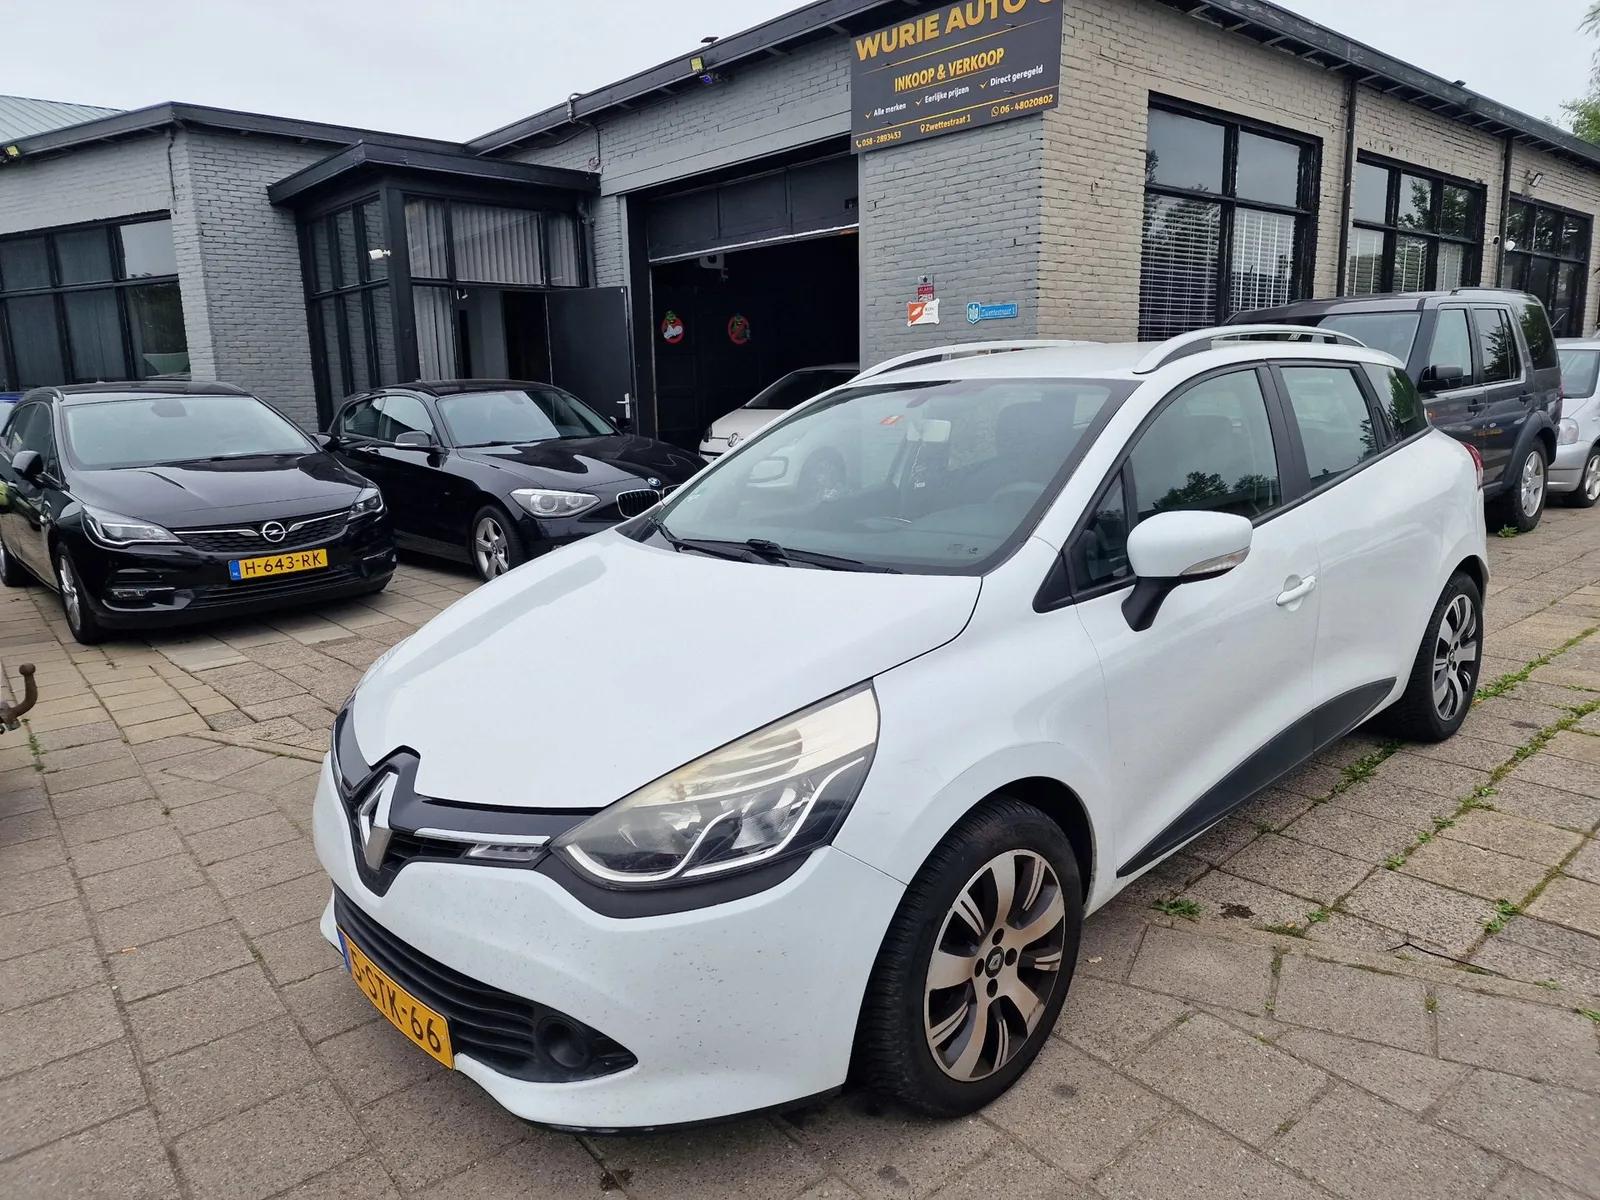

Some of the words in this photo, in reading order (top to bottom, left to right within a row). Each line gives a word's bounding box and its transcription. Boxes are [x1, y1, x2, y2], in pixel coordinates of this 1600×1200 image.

[856, 13, 940, 61] WURIE
[944, 0, 1027, 34] AUTO
[894, 66, 935, 92] INKOOP
[937, 63, 946, 80] &
[948, 47, 1005, 76] VERKOOP
[990, 75, 1011, 87] Direct
[1012, 64, 1044, 84] geregeld
[925, 92, 947, 104] Eerlijke
[948, 86, 970, 100] prijzen
[873, 108, 885, 118] Alle
[886, 102, 907, 116] merken
[925, 115, 966, 133] Zwettestraat
[245, 552, 322, 575] H-643-RK
[350, 947, 442, 1054] 5-STK-66
